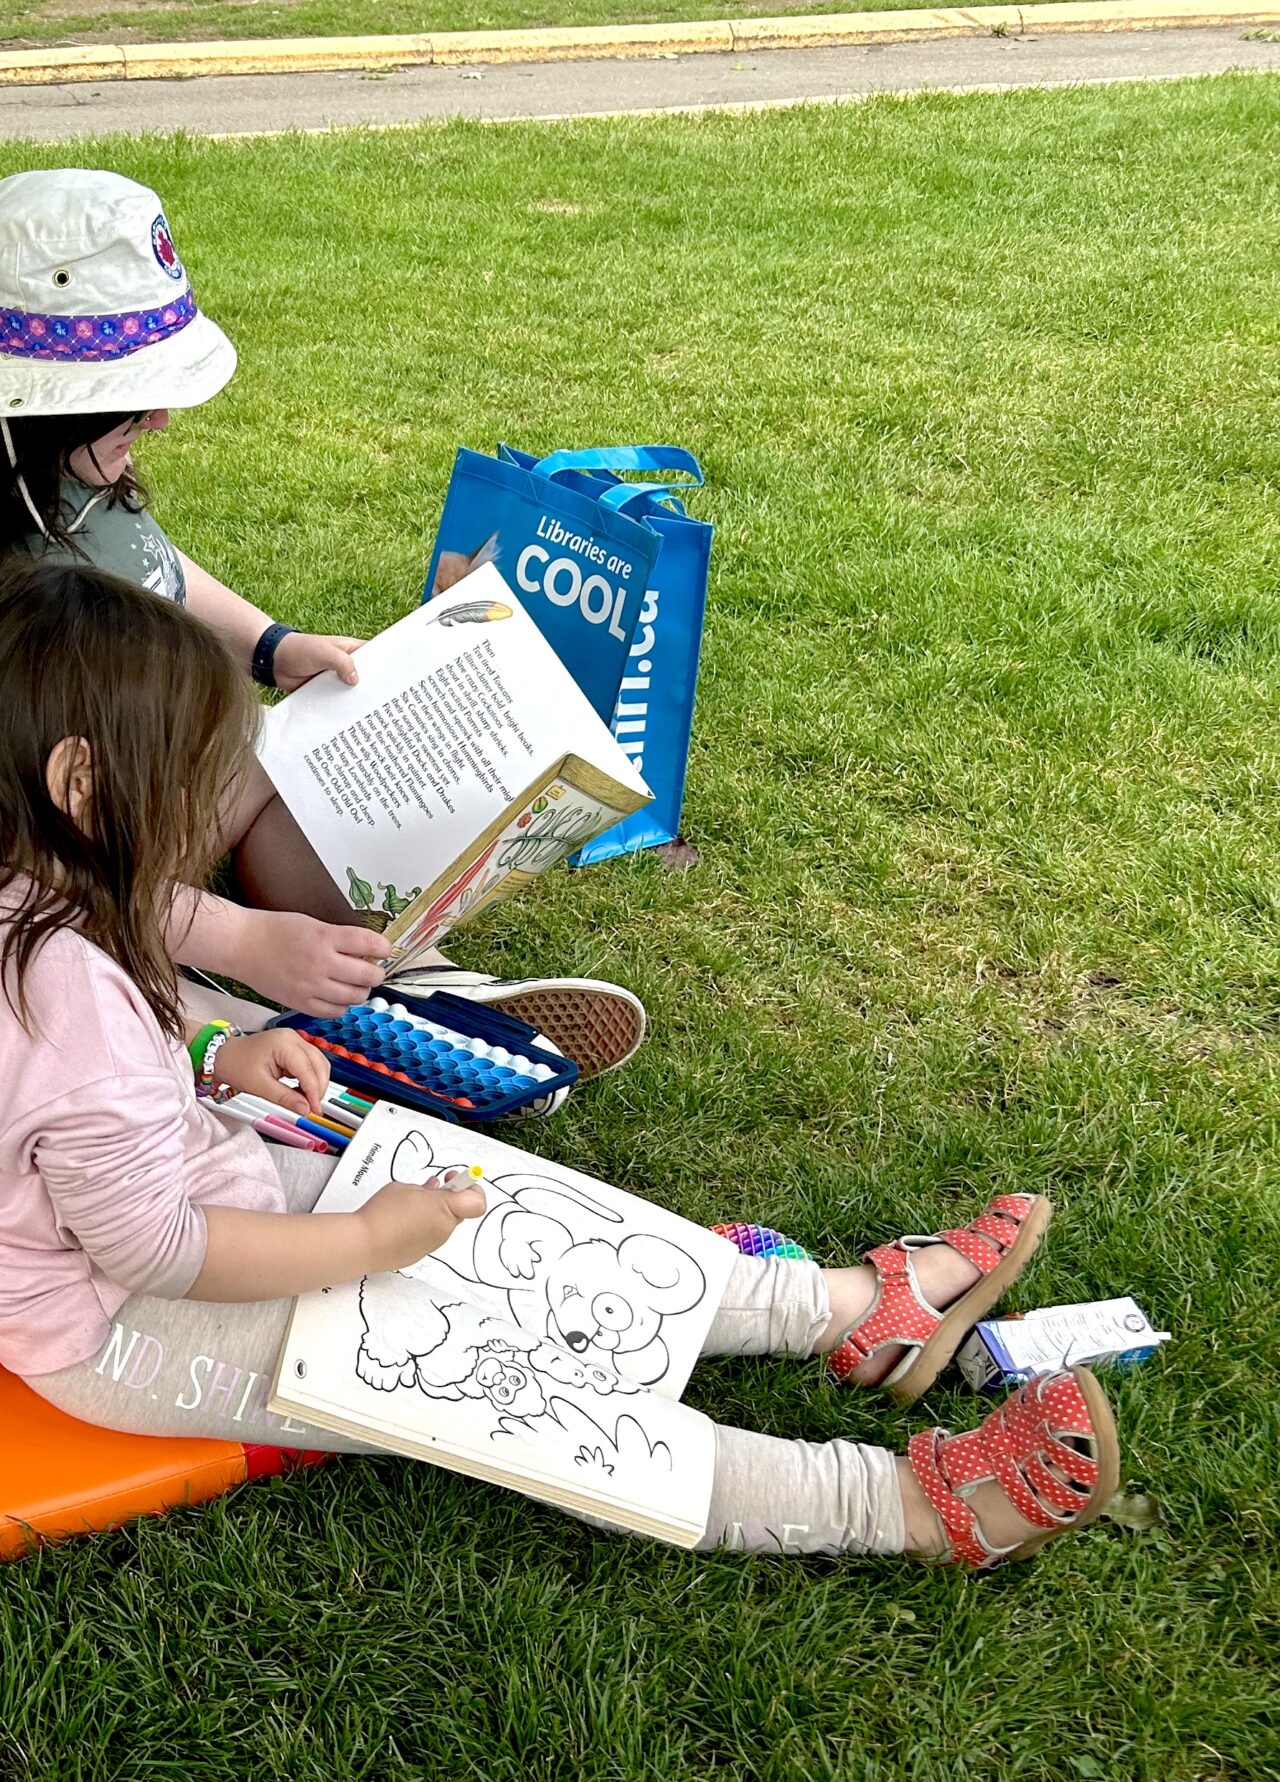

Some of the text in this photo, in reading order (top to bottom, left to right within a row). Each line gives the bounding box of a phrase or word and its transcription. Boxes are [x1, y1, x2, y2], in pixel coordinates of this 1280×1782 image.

[536, 515, 632, 579] Libraries are
[516, 544, 626, 642] COOL
[472, 644, 514, 704] Ten tired Toucans
[481, 638, 496, 659] Then
[399, 691, 410, 705] Six
[407, 703, 430, 735] Canaries
[426, 734, 440, 751] sing
[436, 748, 445, 759] in
[408, 685, 424, 705] whirr
[420, 704, 434, 721] their
[431, 720, 447, 742] wings
[444, 740, 453, 751] in
[427, 674, 447, 701] screech
[443, 700, 457, 715] and
[470, 740, 484, 758] with
[480, 757, 492, 768] all
[487, 767, 502, 785] their
[435, 667, 483, 738] Eight excited Parrots
[444, 663, 461, 683] shout
[456, 681, 465, 691] in
[475, 709, 492, 731] sharp
[489, 730, 509, 758] shrieks.
[454, 656, 504, 729] Nine crazy Cockatoos
[502, 710, 520, 734] bright
[329, 735, 373, 802] Two lazy Lovebirds
[347, 724, 402, 809] Three wily Woodpeckers
[355, 720, 411, 806] noisily knock their knees.
[363, 713, 434, 820] Four fine-feathered Flamingoes
[373, 709, 427, 791] quack quickly in quintet.
[381, 702, 456, 814] Five delightful Ducks and Drakes
[390, 697, 451, 789] their song the sweetest yet.
[417, 679, 494, 793] Seven harmonious Hummingbirds
[303, 754, 344, 818] continues to sleep.
[311, 747, 364, 824] But One Odd Old Owl
[333, 763, 352, 790] chirrup
[349, 789, 364, 805] and
[337, 730, 402, 831] hammer harshly on the trees.
[352, 1143, 382, 1186] Friendly Mouse
